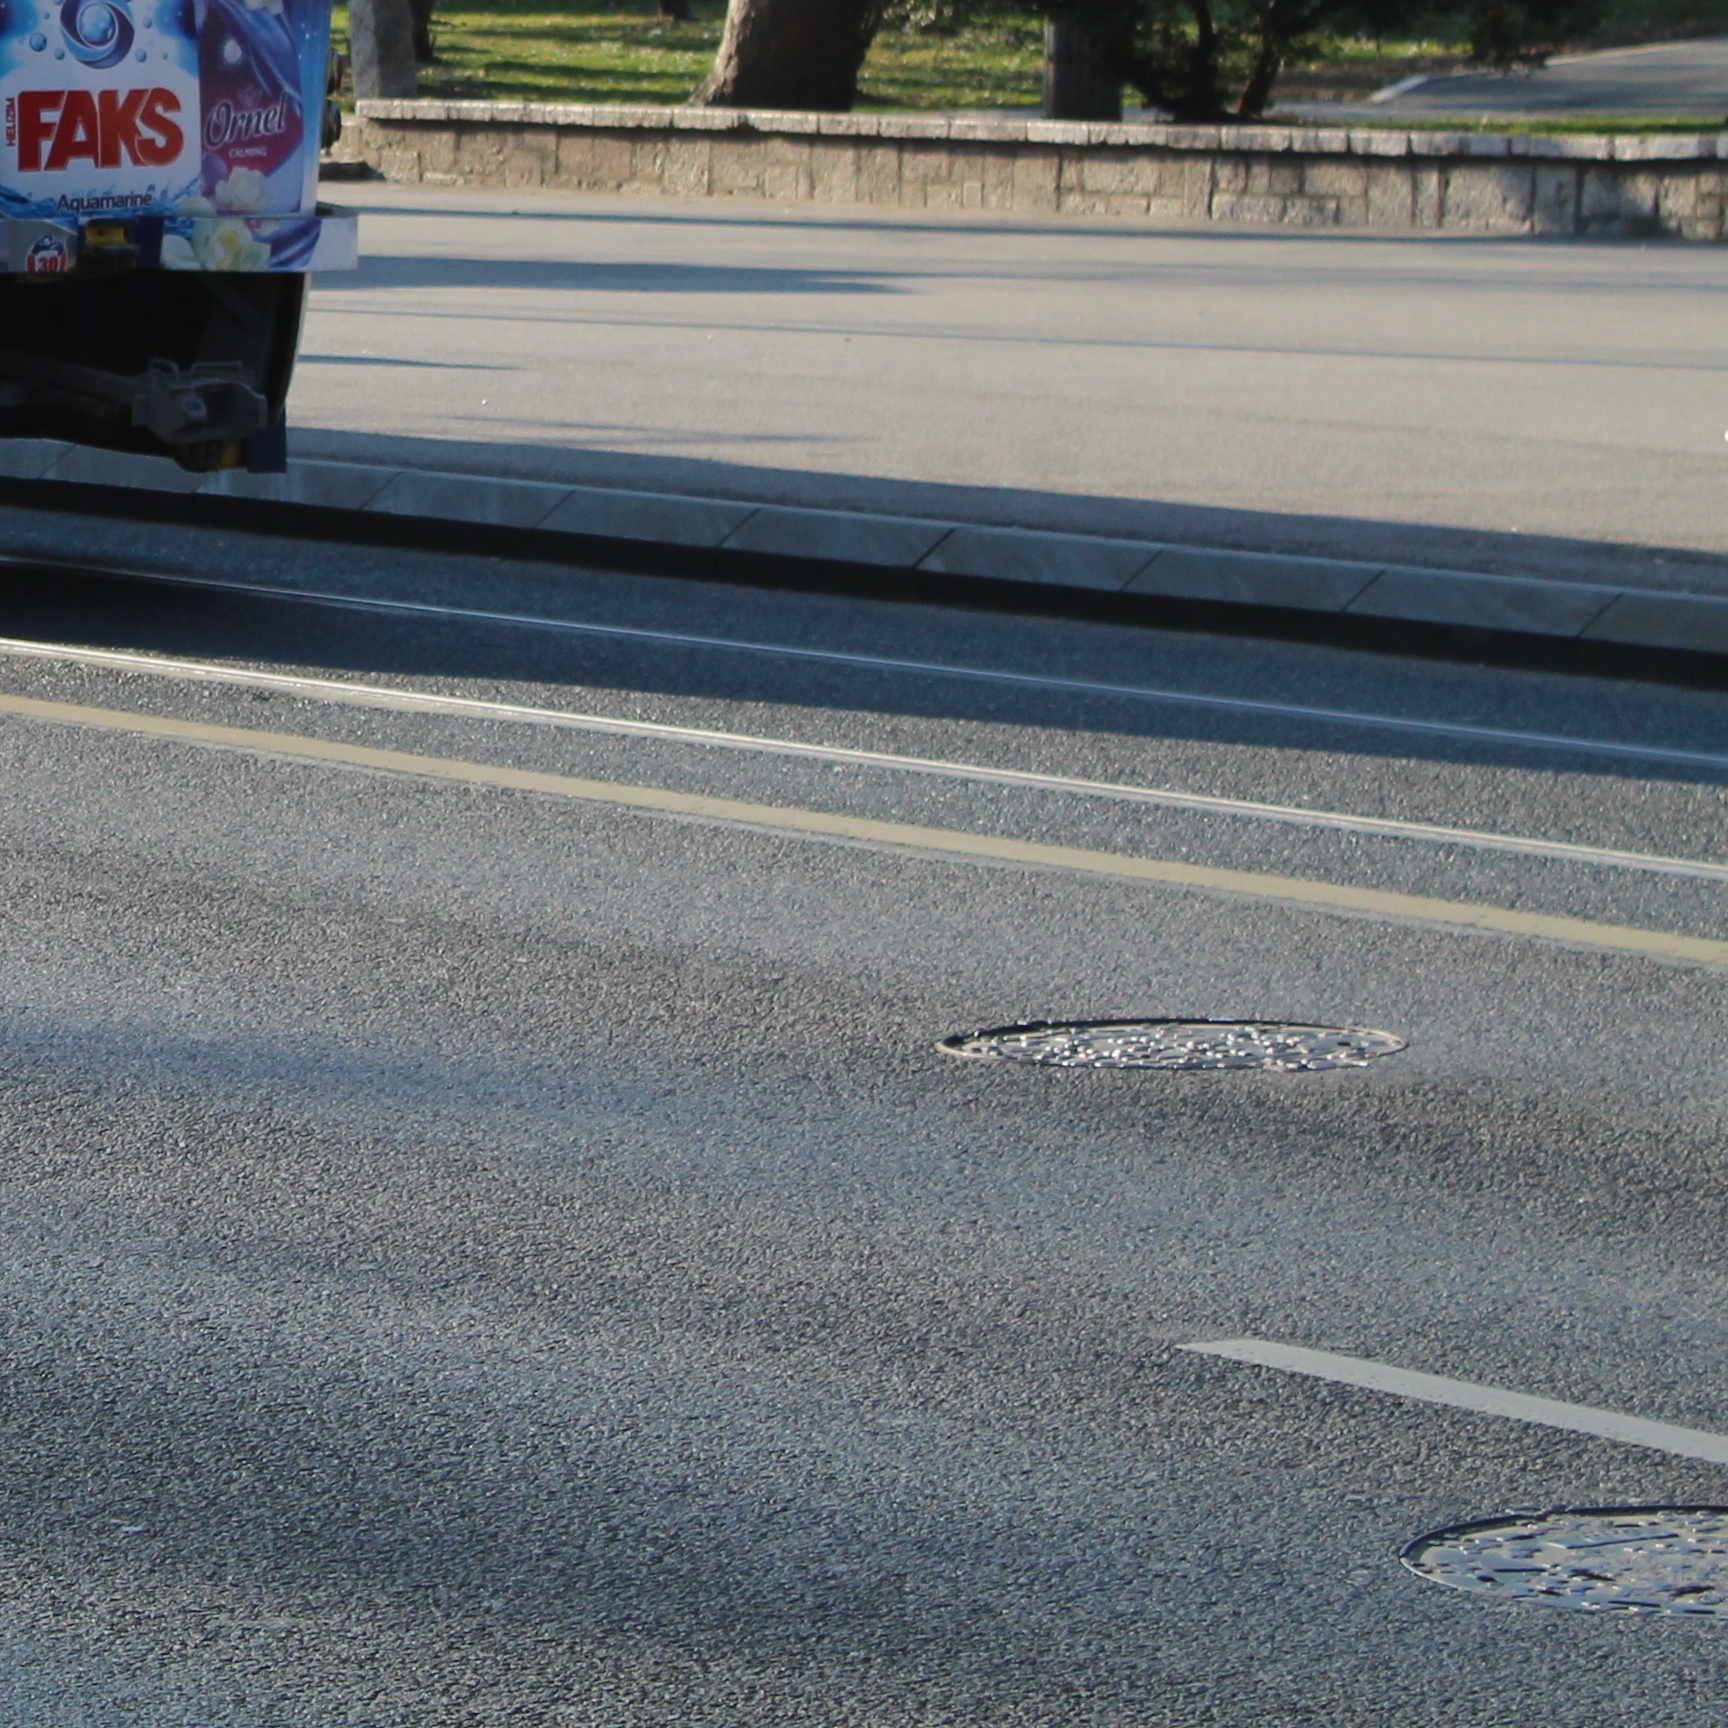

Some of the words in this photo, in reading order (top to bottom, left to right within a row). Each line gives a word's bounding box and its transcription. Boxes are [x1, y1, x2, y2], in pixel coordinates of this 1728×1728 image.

[17, 87, 185, 173] FAKS
[204, 92, 287, 149] Ornel
[56, 191, 154, 214] Aquamarine
